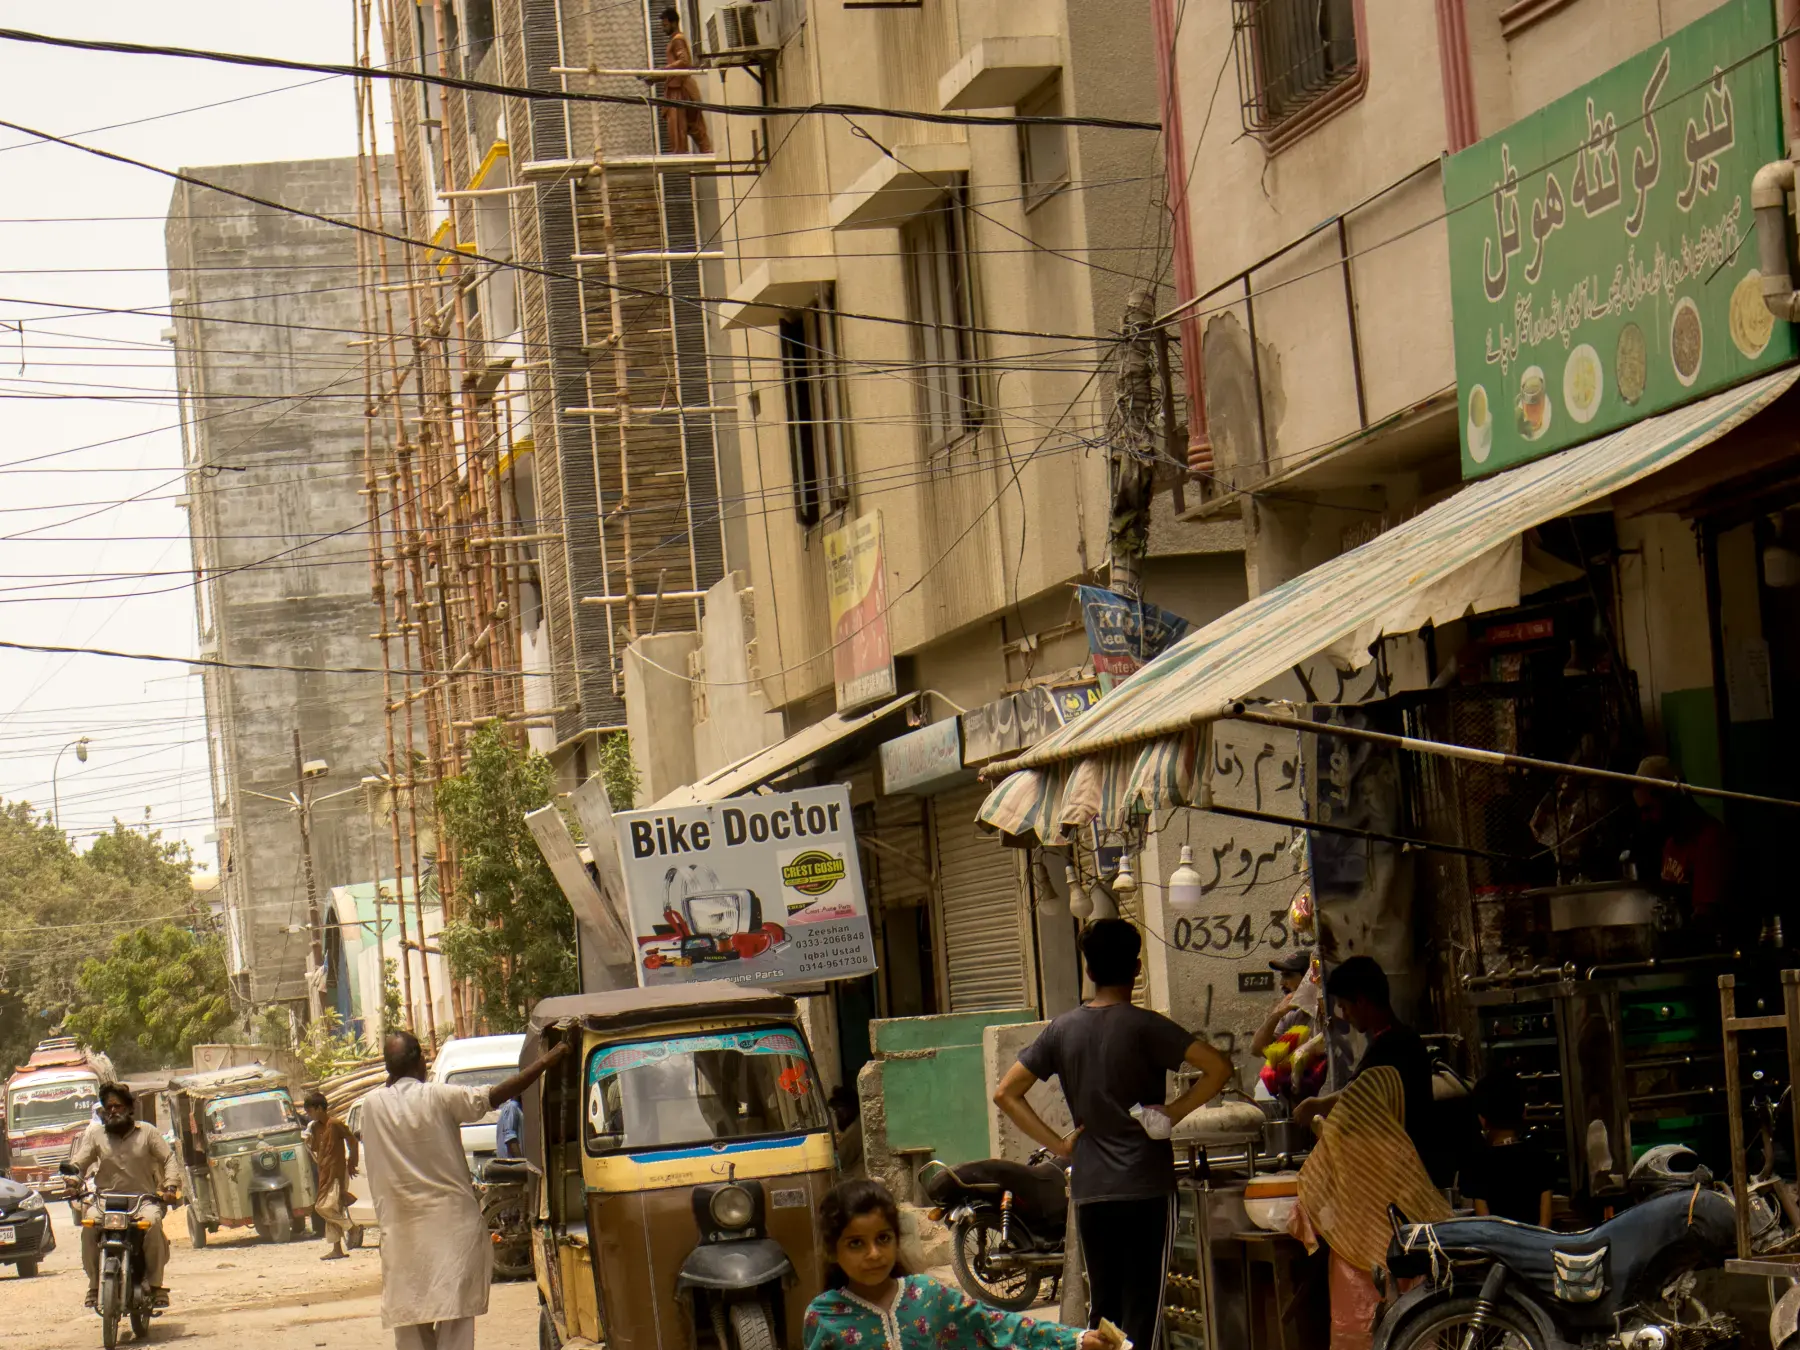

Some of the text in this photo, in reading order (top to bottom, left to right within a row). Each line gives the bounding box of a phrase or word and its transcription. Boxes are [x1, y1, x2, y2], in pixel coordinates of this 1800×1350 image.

[1677, 65, 1735, 212] نیو
[630, 816, 711, 859] Bike
[722, 801, 841, 846] Doctor
[783, 860, 843, 879] CREST GOSHI
[808, 925, 850, 937] Zeeshan
[796, 931, 865, 949] 0333-2066848
[804, 945, 861, 961] Iqbal Ustad
[799, 955, 868, 972] 0314-9617308
[755, 969, 784, 979] Parts
